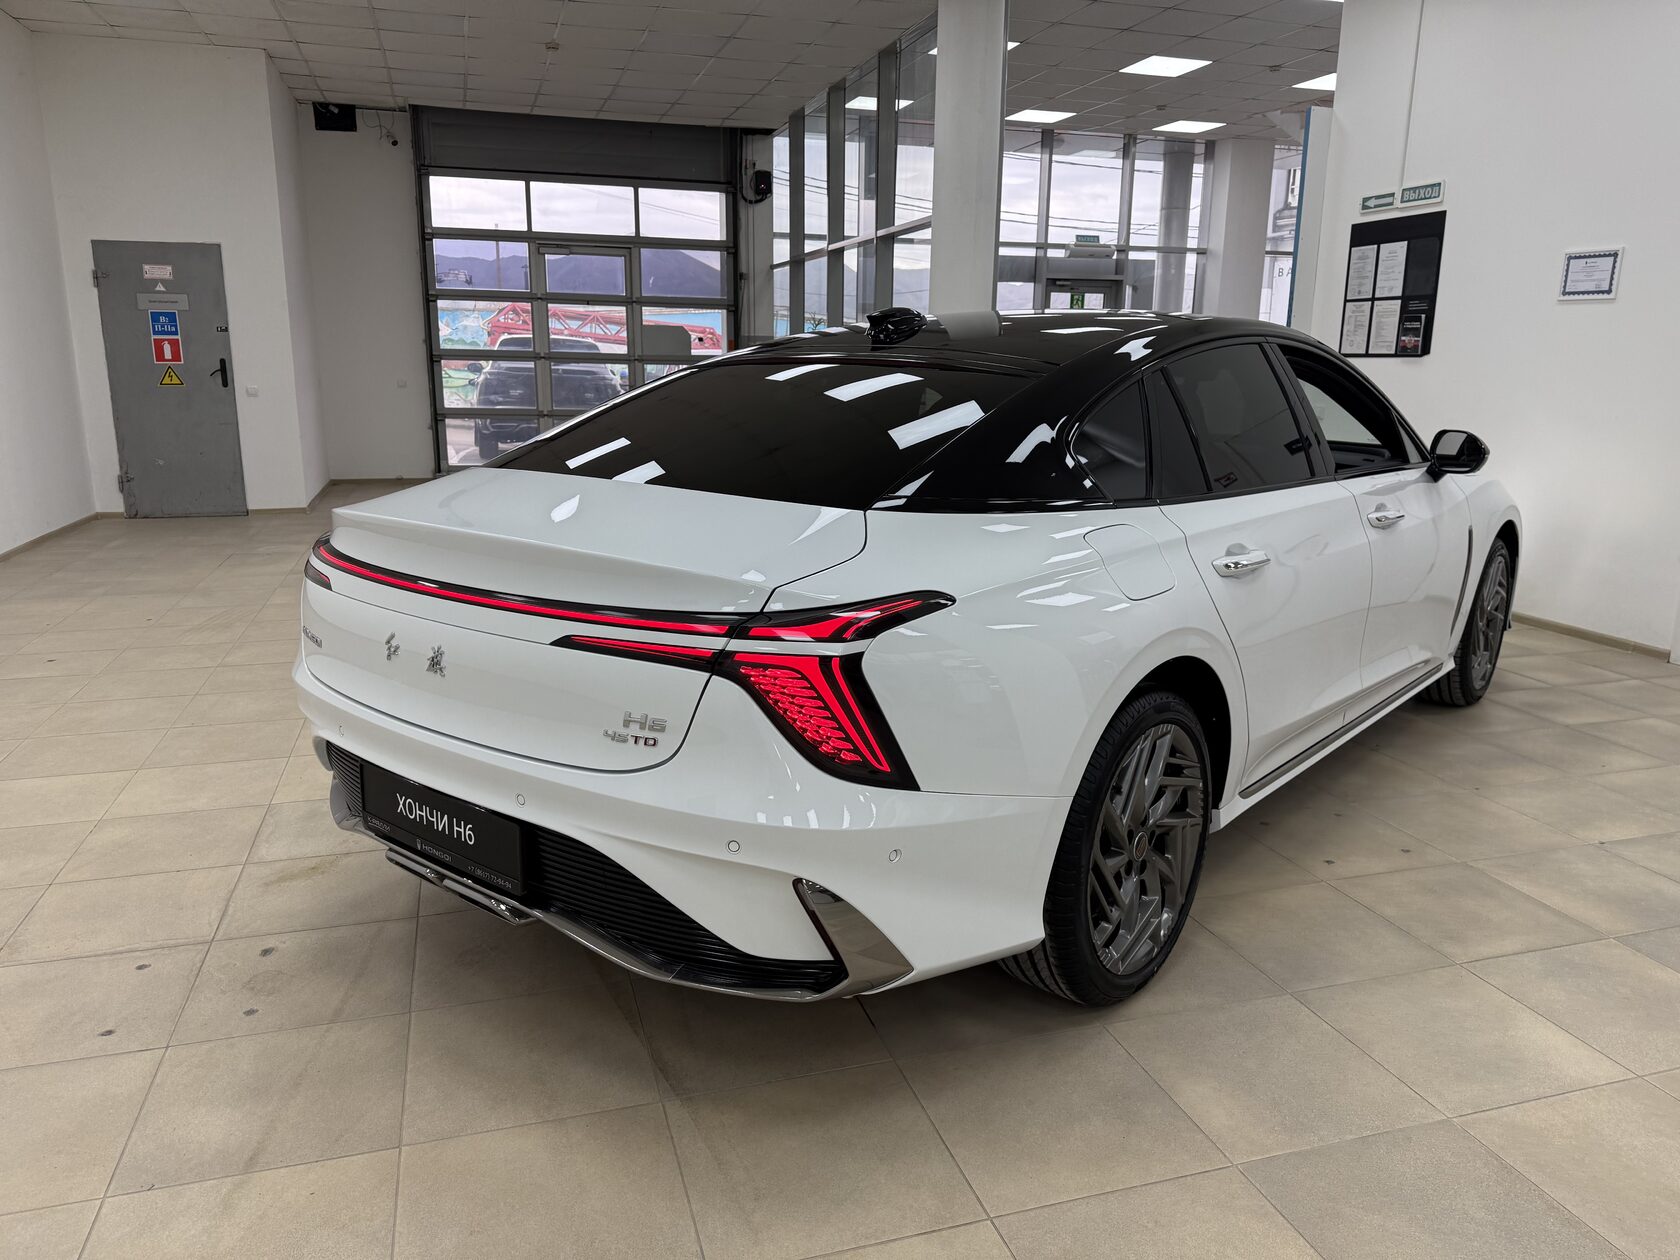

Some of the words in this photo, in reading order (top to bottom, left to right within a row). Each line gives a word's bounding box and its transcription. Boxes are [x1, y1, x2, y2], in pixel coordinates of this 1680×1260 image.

[1402, 185, 1440, 201] ВЫХОД
[623, 711, 667, 733] H6
[396, 793, 449, 835] ХОНЧИ
